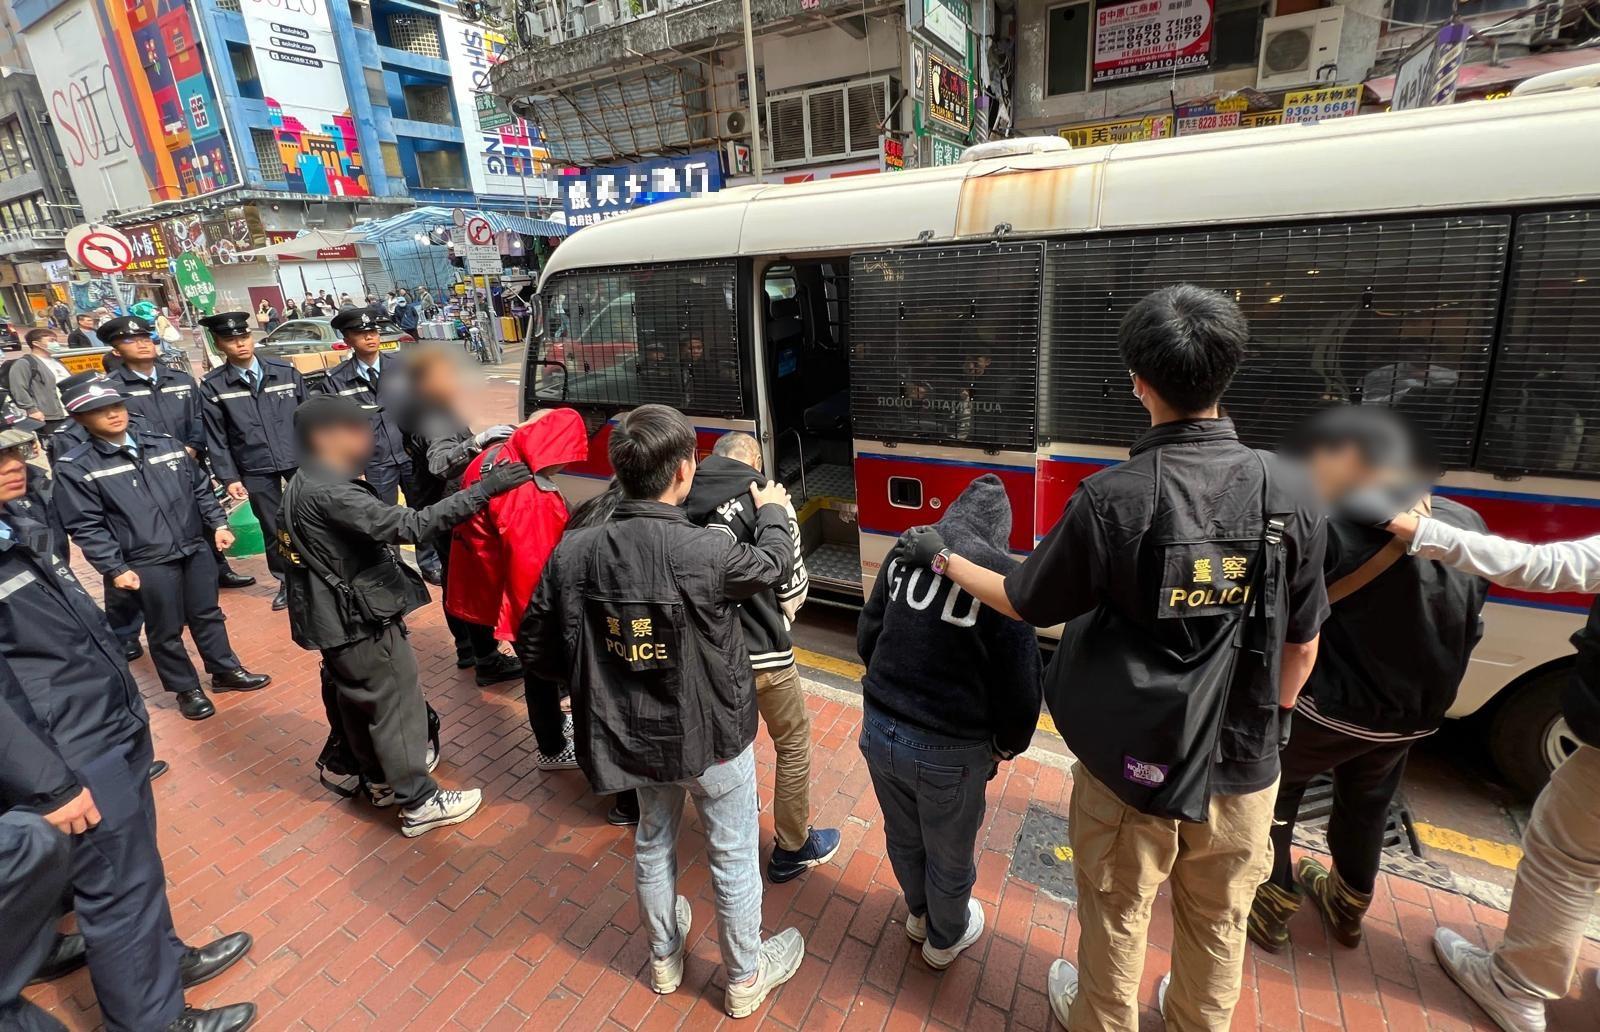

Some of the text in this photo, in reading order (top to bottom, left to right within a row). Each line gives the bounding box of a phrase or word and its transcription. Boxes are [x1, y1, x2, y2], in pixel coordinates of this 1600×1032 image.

[1127, 23, 1161, 35] 9788
[1127, 31, 1161, 41] 9870
[1127, 38, 1160, 49] 6130
[1145, 59, 1172, 70] 2810
[1177, 54, 1206, 66] 6066
[52, 64, 135, 167] SOLO
[1286, 101, 1356, 116] 9363 6681
[1198, 116, 1217, 129] 8228
[1218, 113, 1238, 127] 3553
[1299, 112, 1313, 123] For
[1193, 556, 1247, 582] 警察
[606, 616, 653, 638] 警察
[605, 638, 668, 661] POLICE
